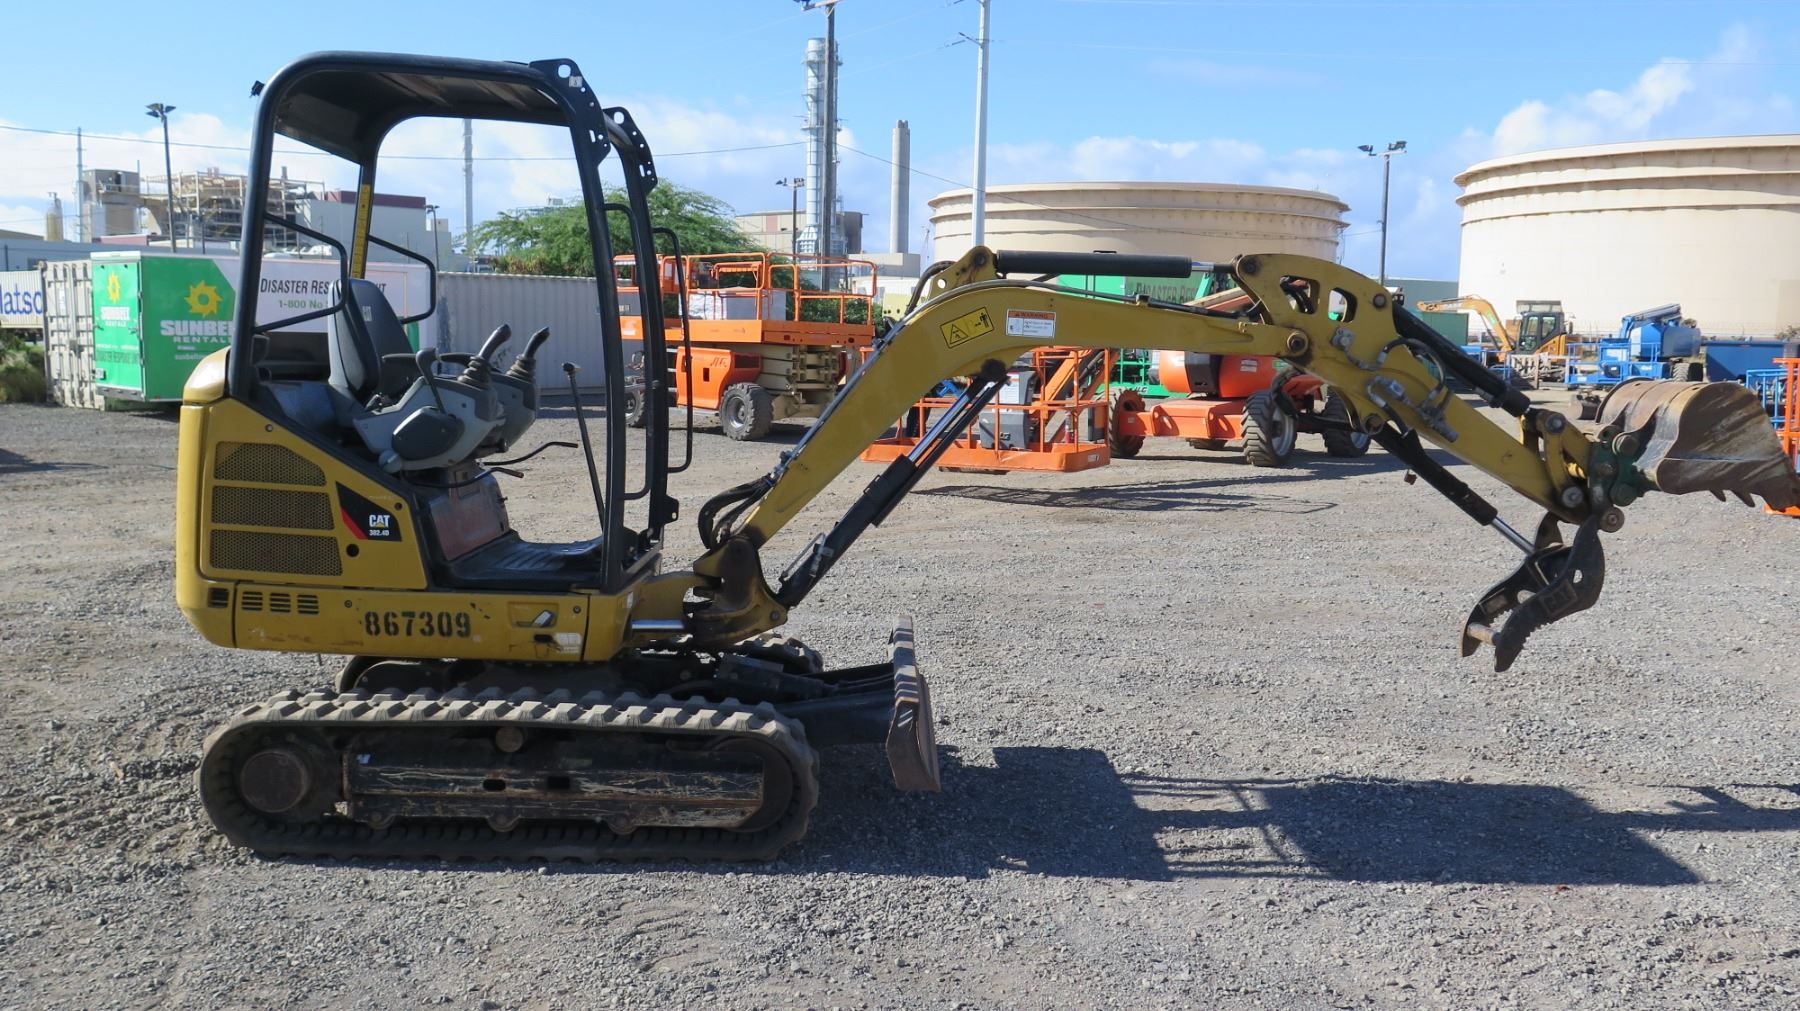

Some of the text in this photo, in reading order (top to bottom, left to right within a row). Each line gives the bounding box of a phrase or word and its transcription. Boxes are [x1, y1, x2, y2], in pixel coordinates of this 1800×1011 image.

[260, 278, 307, 294] DISASTER
[0, 283, 43, 315] atso
[279, 300, 306, 309] 1-800
[369, 515, 390, 528] CAT
[365, 611, 471, 637] 867309
